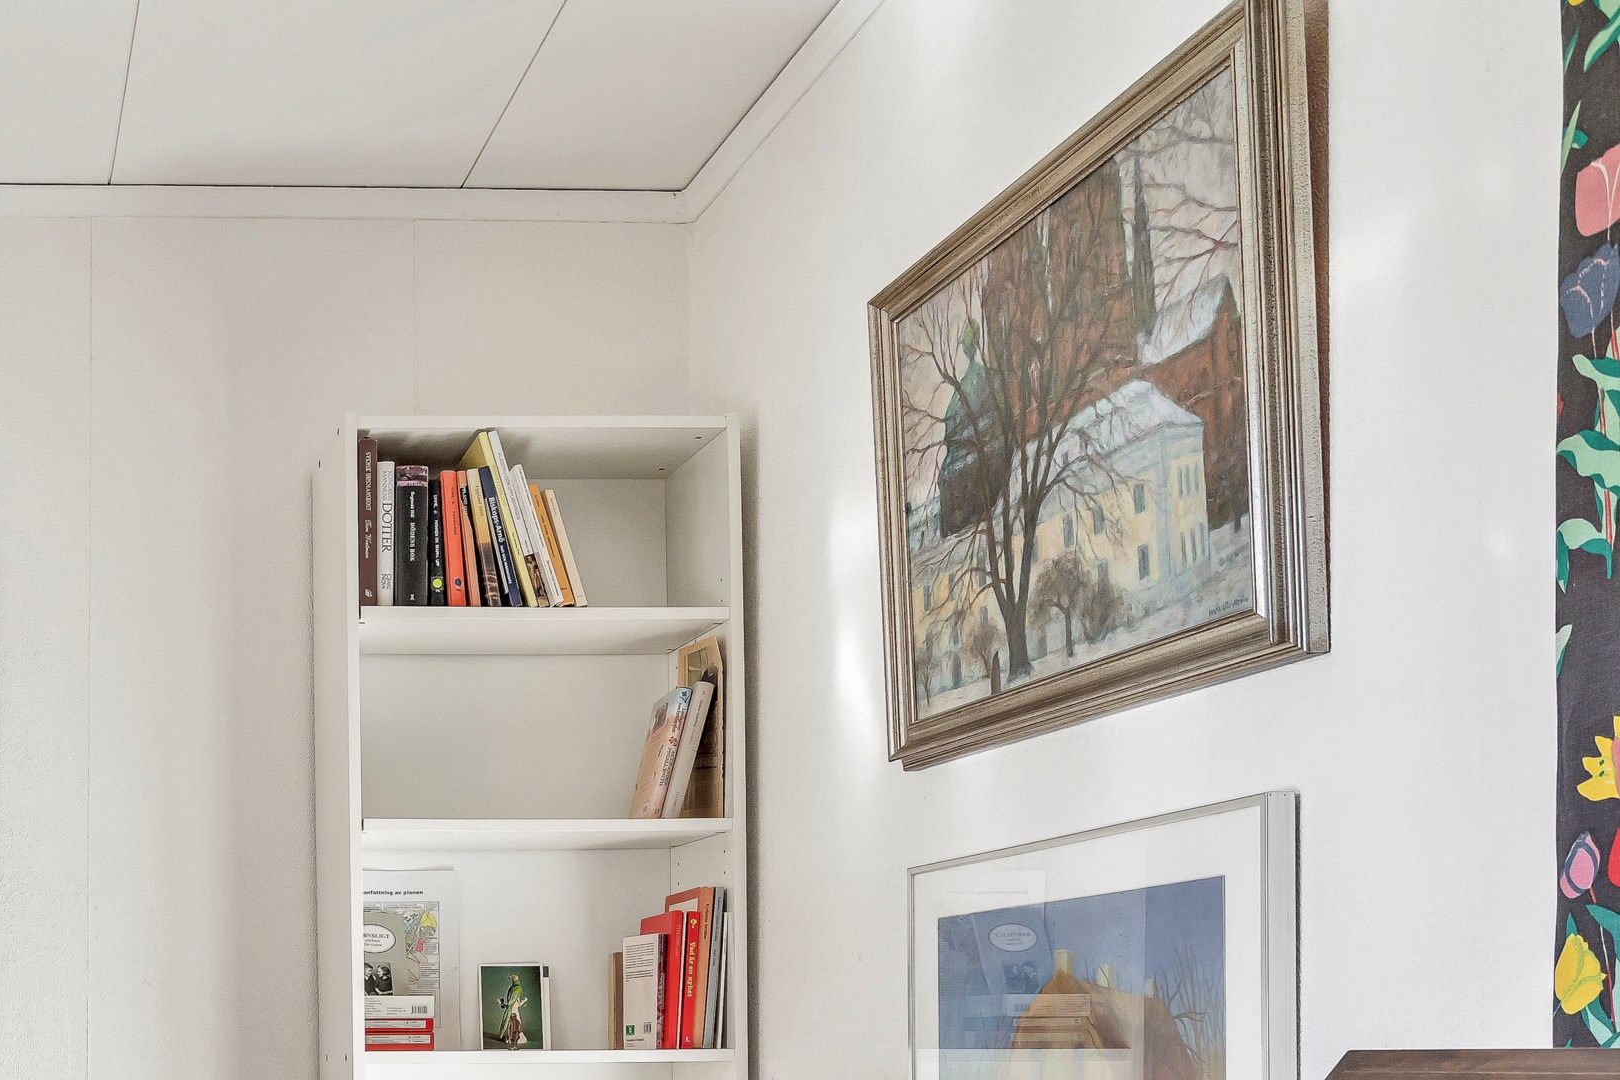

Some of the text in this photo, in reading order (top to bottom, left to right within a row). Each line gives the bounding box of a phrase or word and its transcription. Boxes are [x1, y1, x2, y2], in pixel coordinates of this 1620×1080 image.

[381, 503, 393, 553] DOTTER
[488, 497, 505, 543] Biskops-Arnö
[688, 956, 695, 965] är
[686, 976, 694, 998] nyhet
